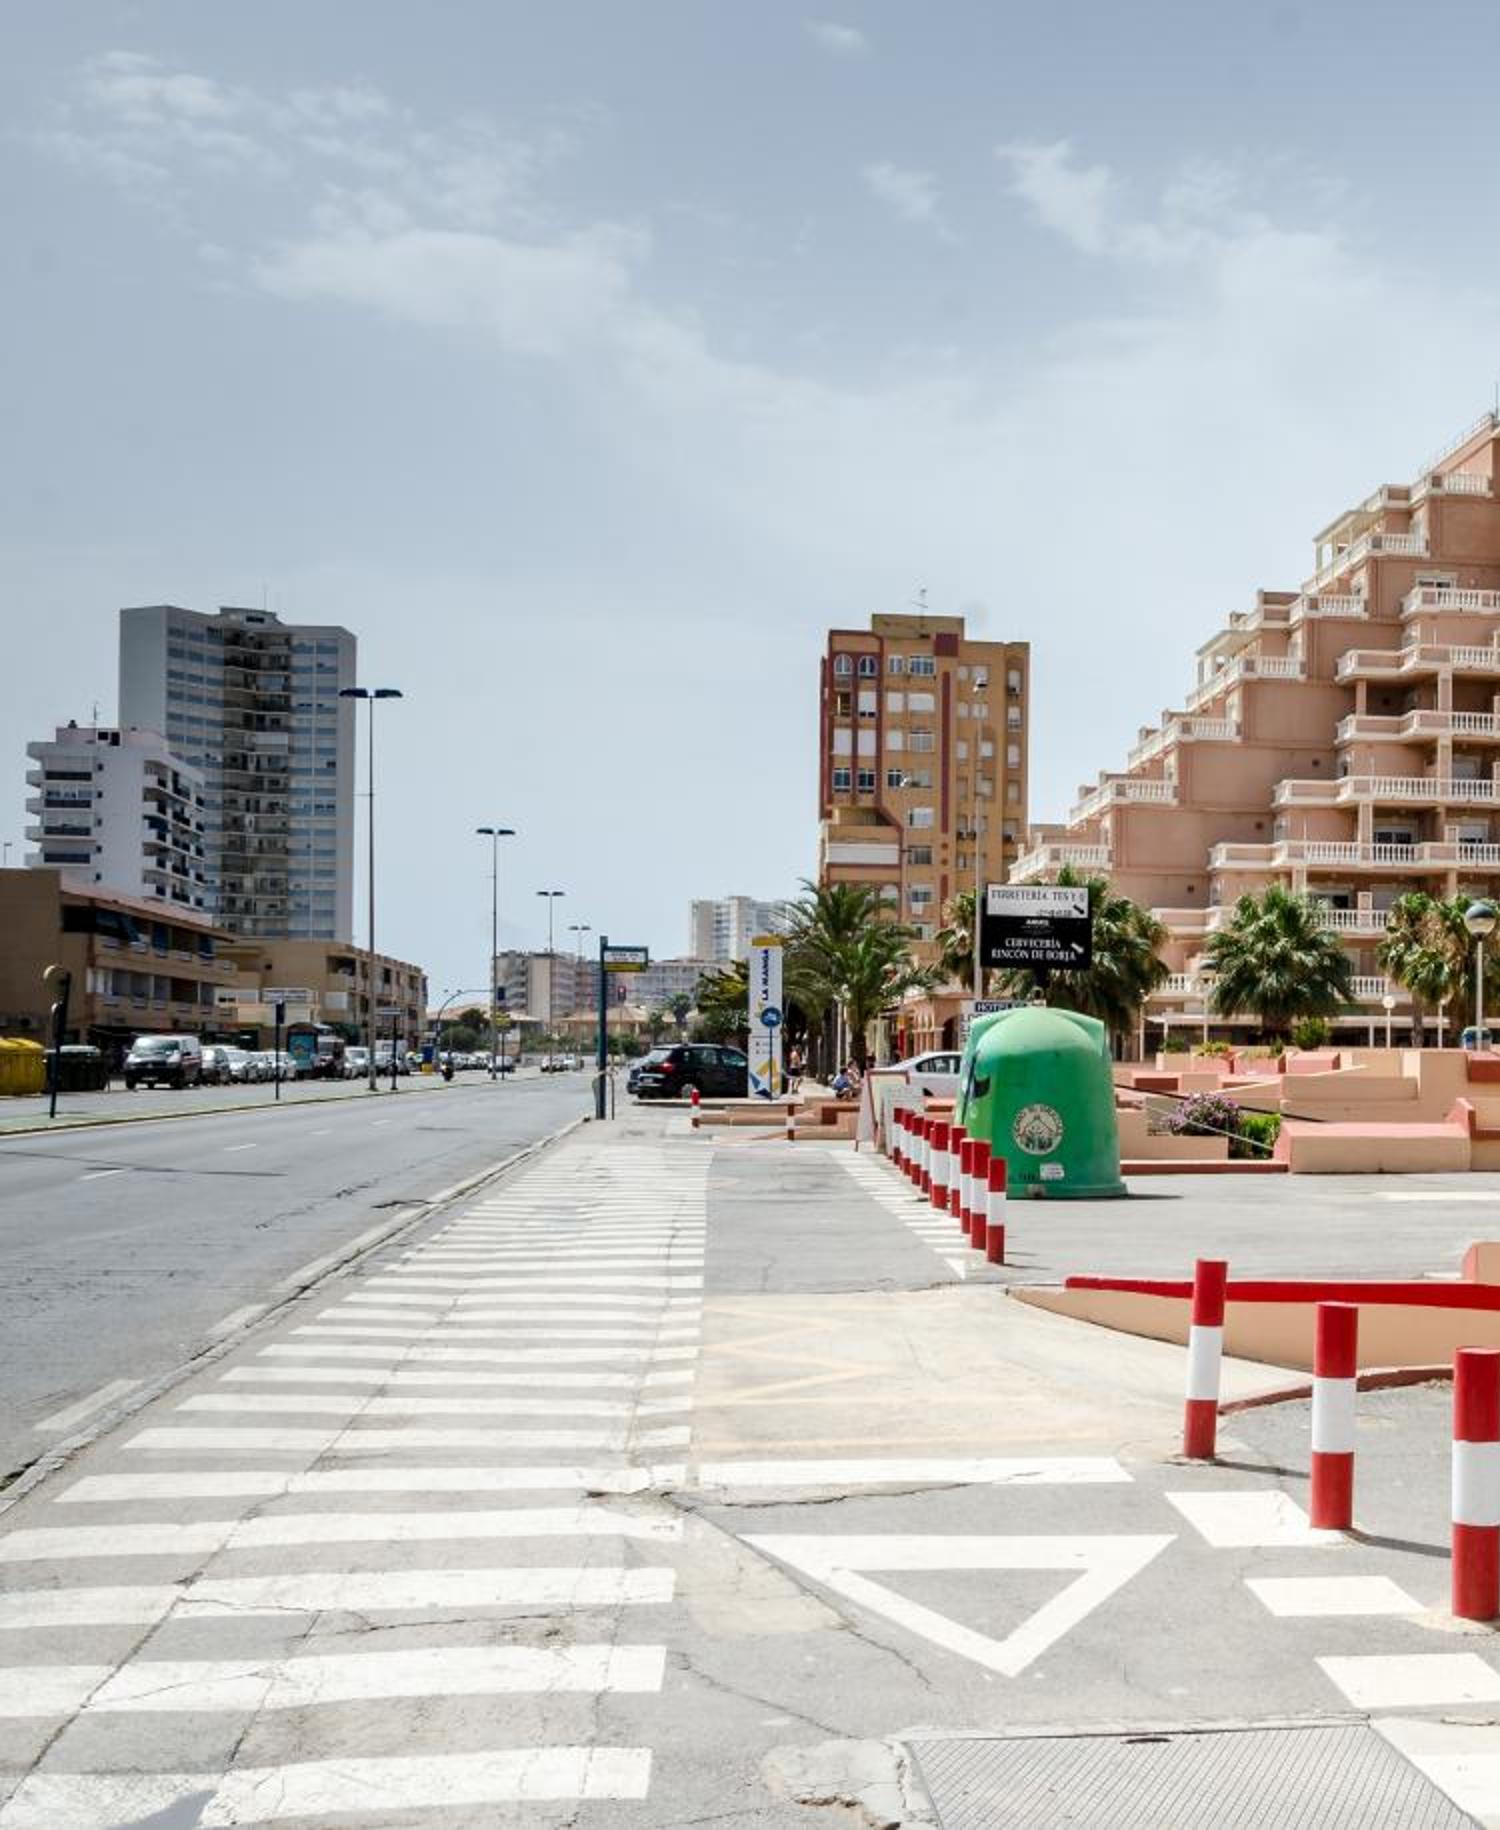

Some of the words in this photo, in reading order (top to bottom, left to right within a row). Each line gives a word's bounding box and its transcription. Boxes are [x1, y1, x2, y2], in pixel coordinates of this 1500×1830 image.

[1005, 936, 1061, 949] CERVECERÍA
[991, 947, 1029, 960] RINCÓN
[1031, 950, 1044, 960] DE
[1045, 950, 1077, 962] BORJA
